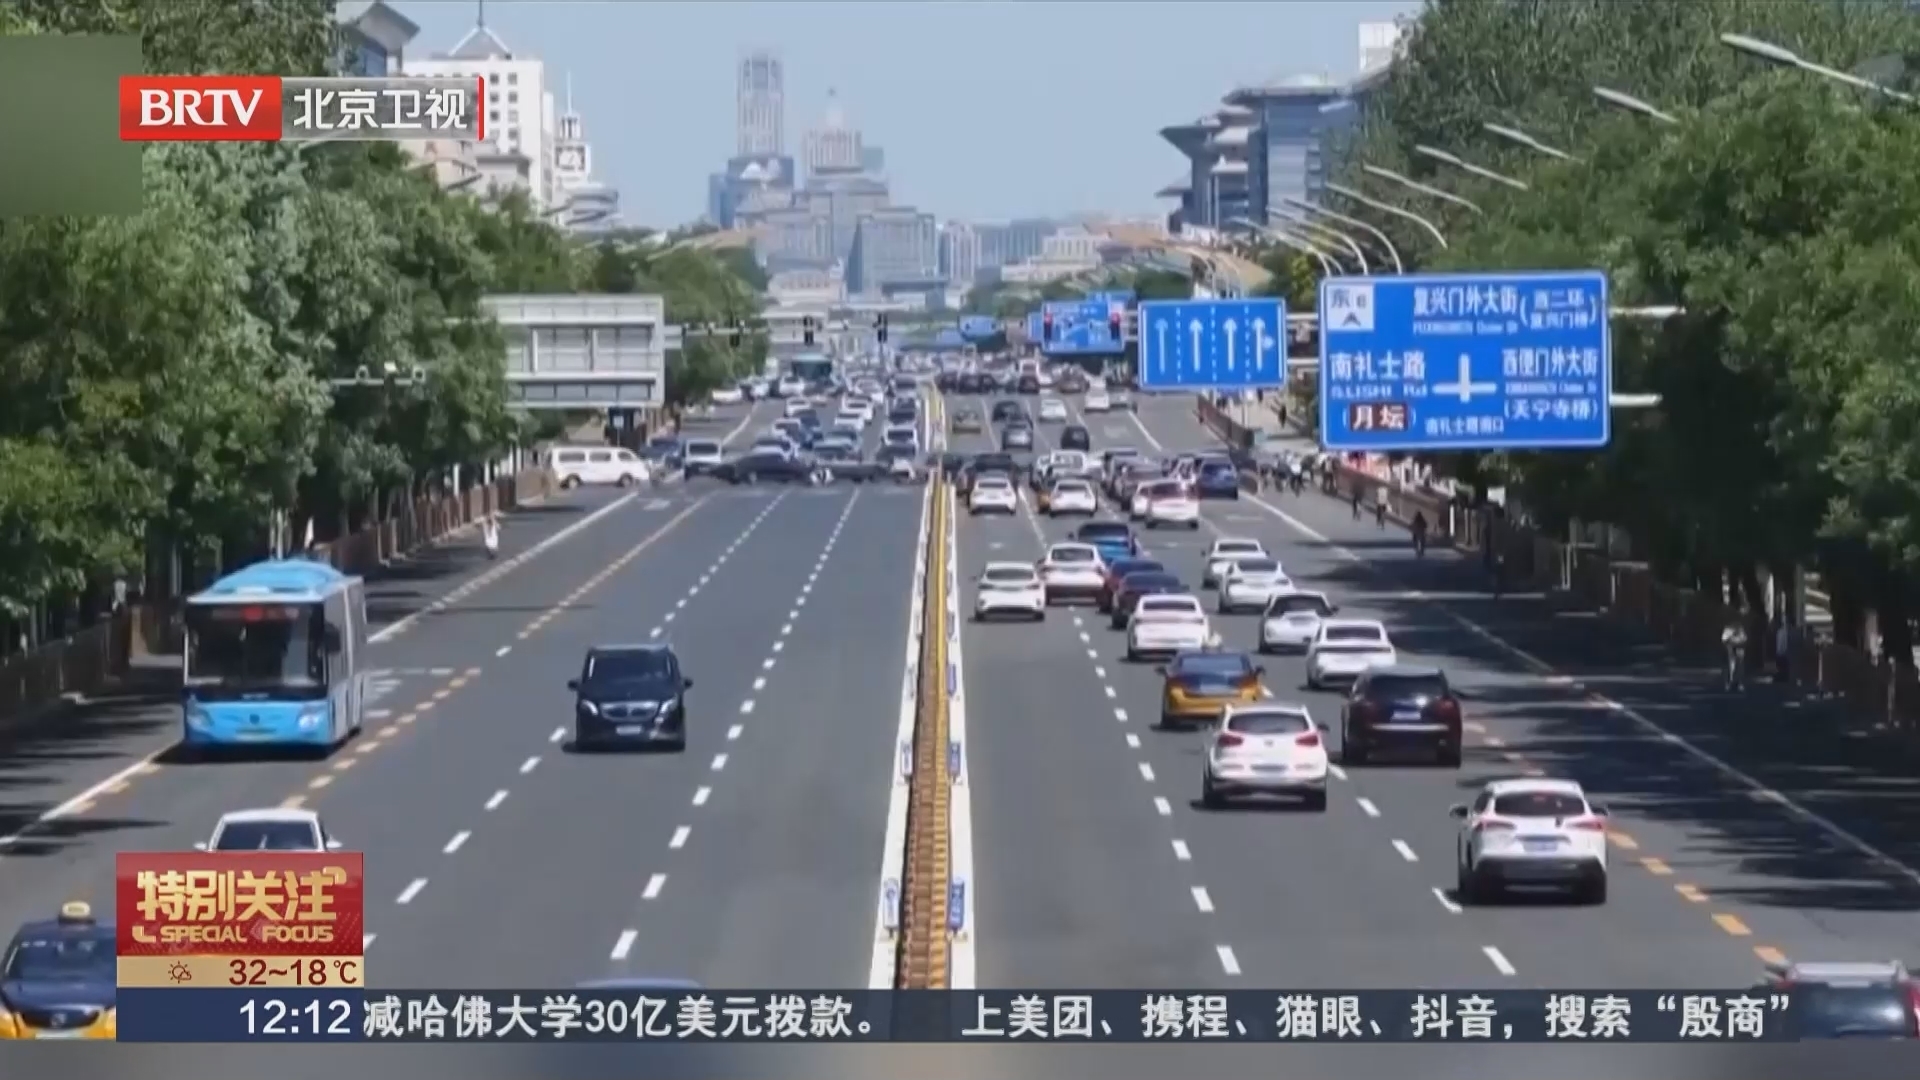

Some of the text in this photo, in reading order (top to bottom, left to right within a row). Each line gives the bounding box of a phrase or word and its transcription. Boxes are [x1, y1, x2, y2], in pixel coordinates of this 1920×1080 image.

[1413, 285, 1518, 317] 复兴门外大街
[1329, 349, 1425, 381] 南礼士路
